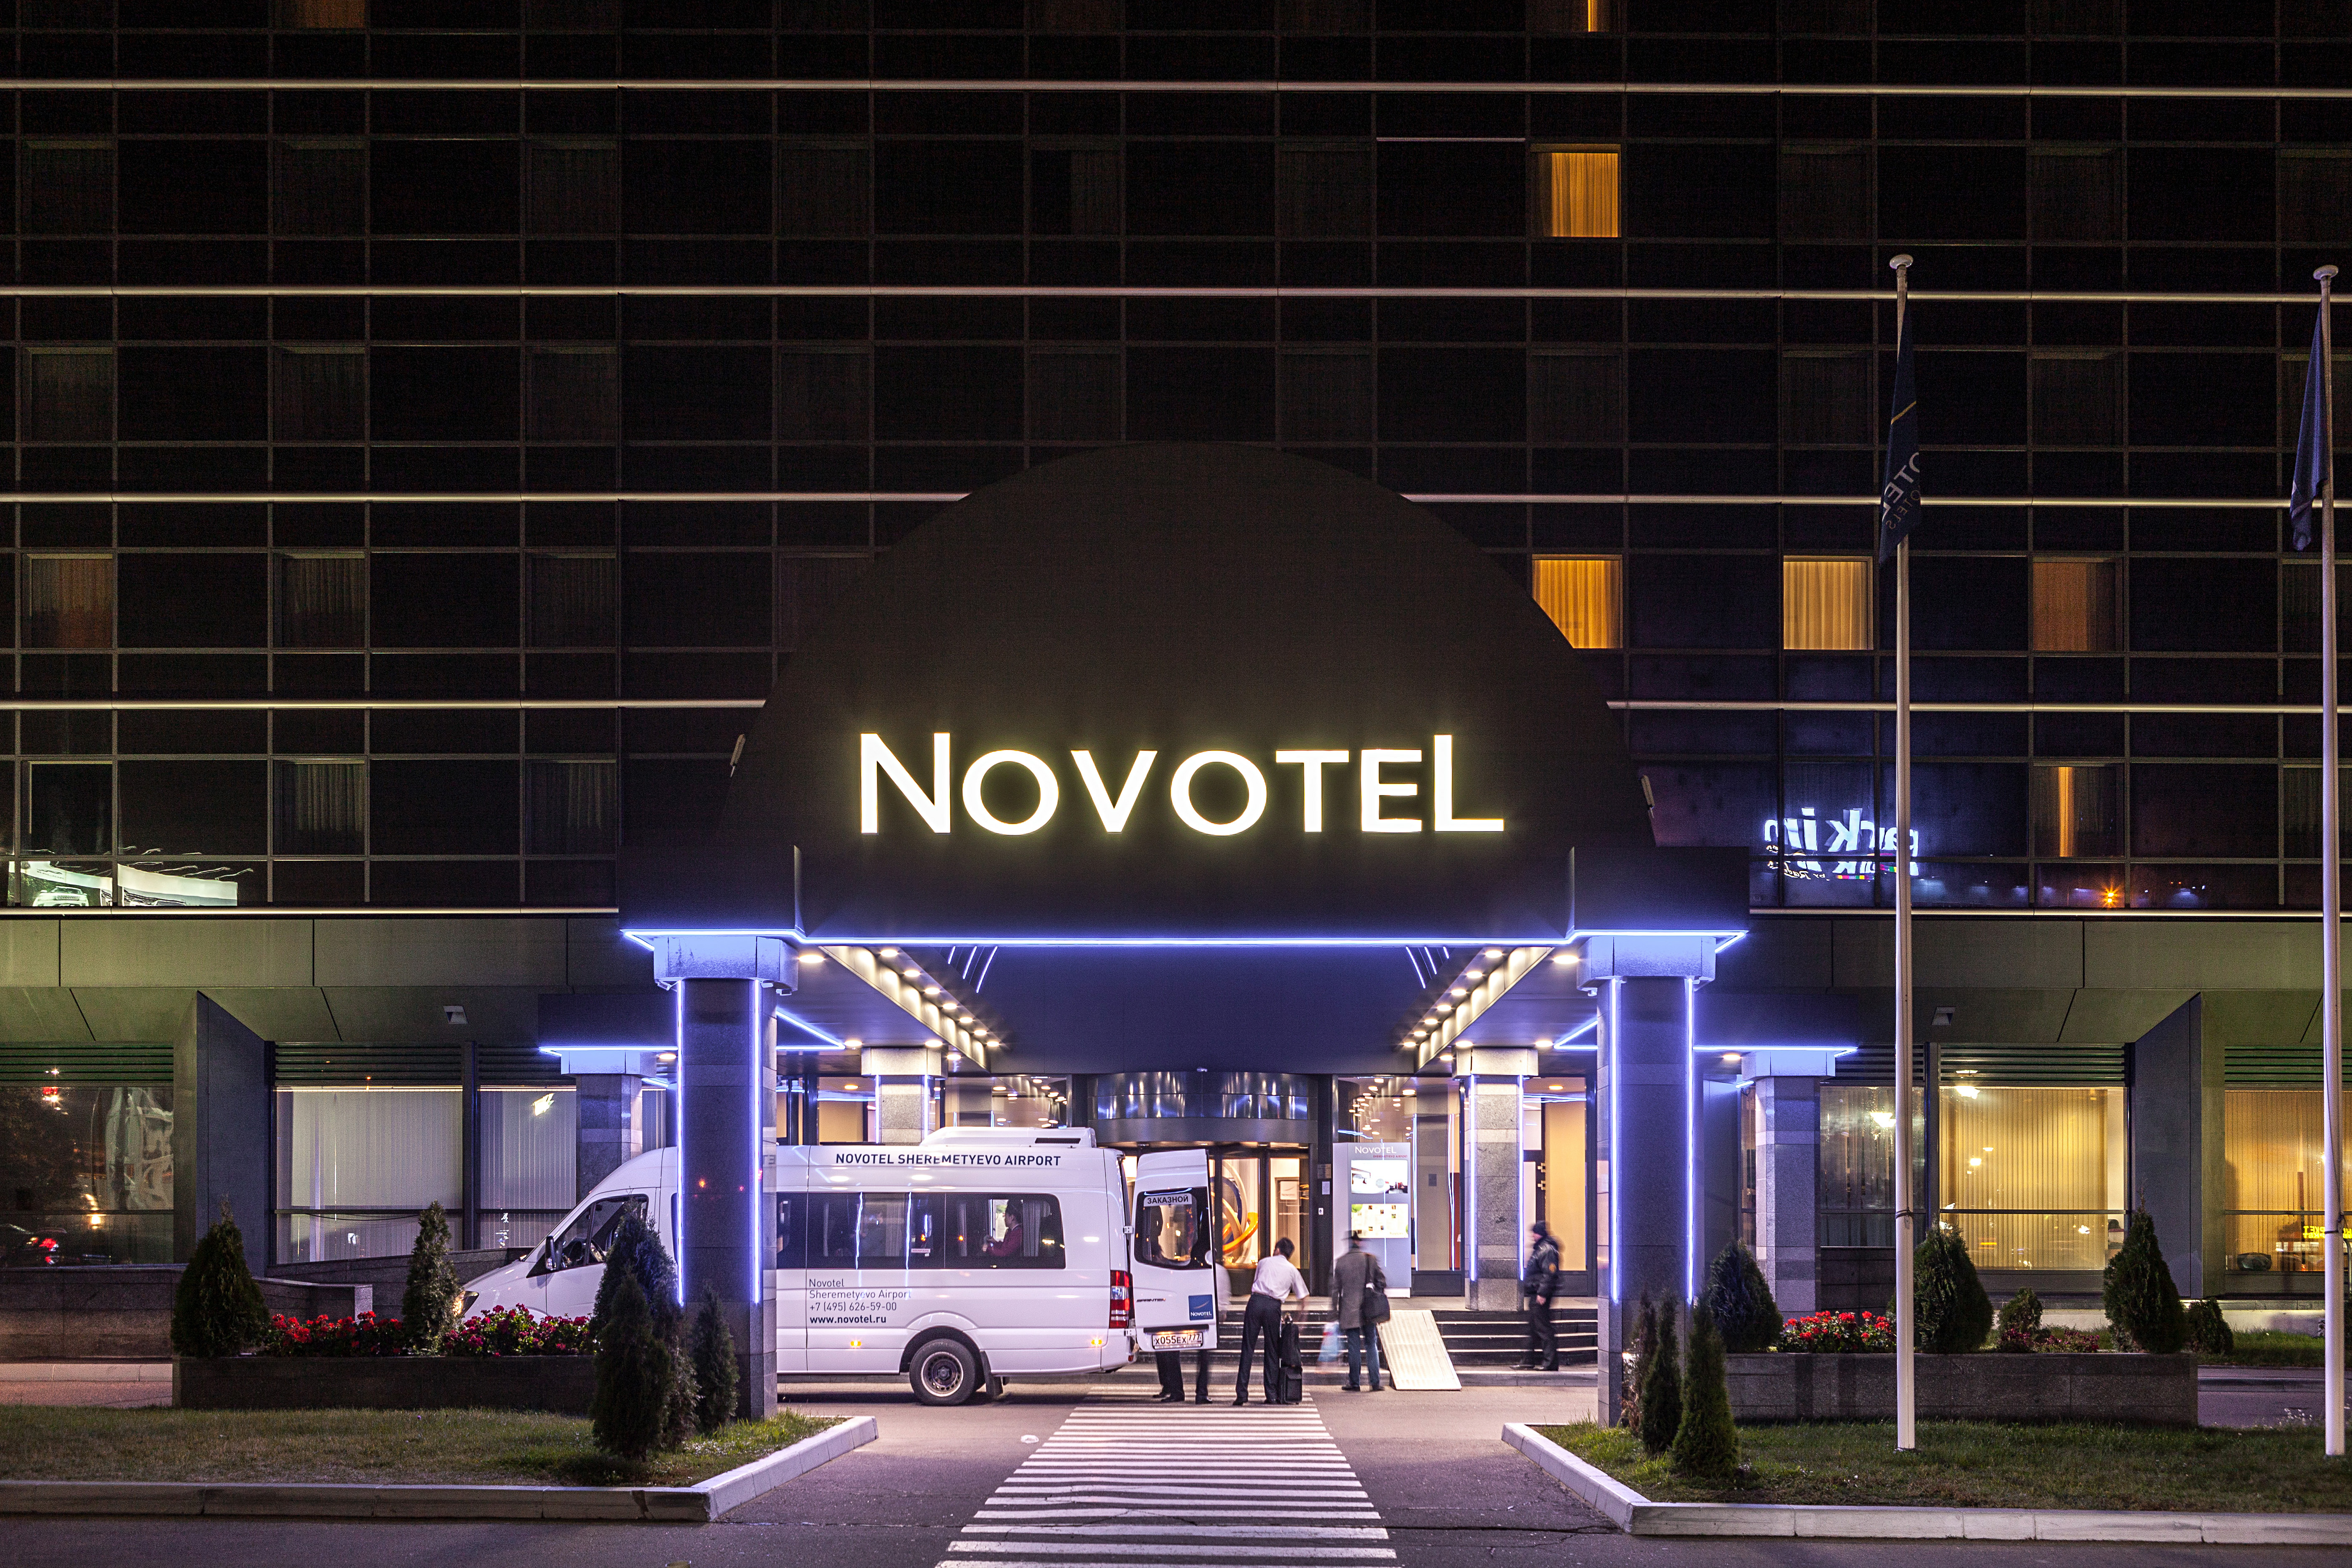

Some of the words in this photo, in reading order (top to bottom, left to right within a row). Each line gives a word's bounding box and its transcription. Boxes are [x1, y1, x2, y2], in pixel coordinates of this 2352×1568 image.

[860, 732, 1504, 836] NOVOTEL
[836, 1153, 894, 1164] NOVOTEL
[898, 1154, 1001, 1165] SHEREMETYEVO
[1005, 1155, 1061, 1166] AIRPORT
[1147, 1194, 1189, 1204] ЗАКАЗНОЙ
[809, 1279, 844, 1287] Novotel
[810, 1290, 875, 1300] Sheremetyevo
[878, 1289, 911, 1300] Airport
[810, 1302, 820, 1311] +7
[824, 1301, 846, 1312] (495)
[849, 1302, 897, 1311] 626-59-00
[810, 1315, 886, 1323] www.novotel.ru
